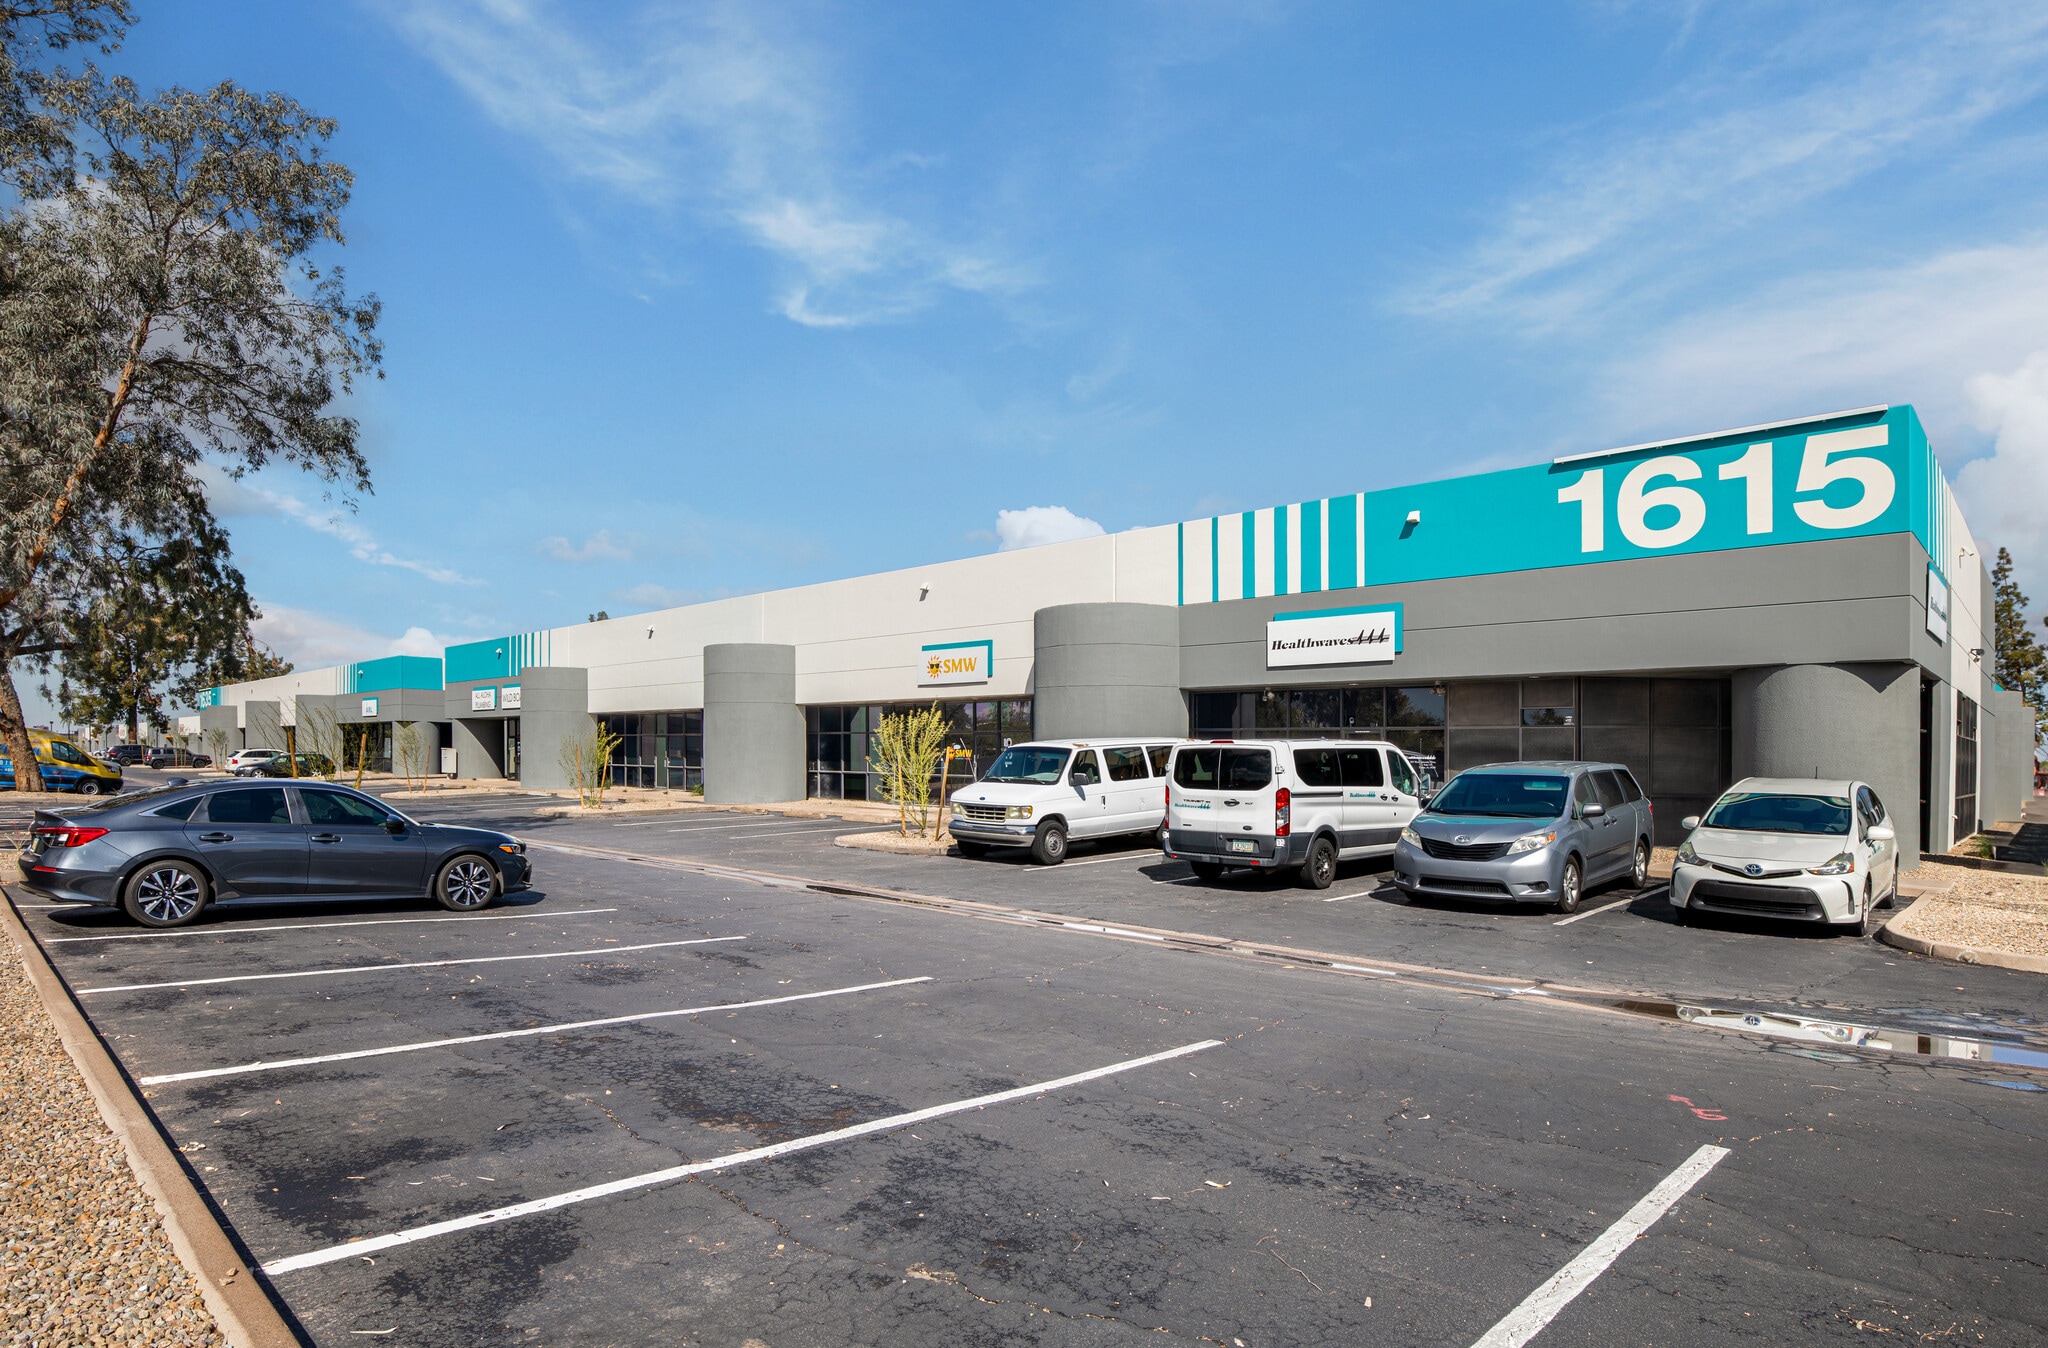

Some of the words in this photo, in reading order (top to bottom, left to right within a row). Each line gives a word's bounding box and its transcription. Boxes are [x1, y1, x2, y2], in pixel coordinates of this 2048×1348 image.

[1557, 424, 1896, 553] 1615
[1271, 637, 1354, 651] Healthwaves
[943, 656, 978, 674] SMW
[513, 692, 521, 702] BO
[955, 749, 973, 758] SMW
